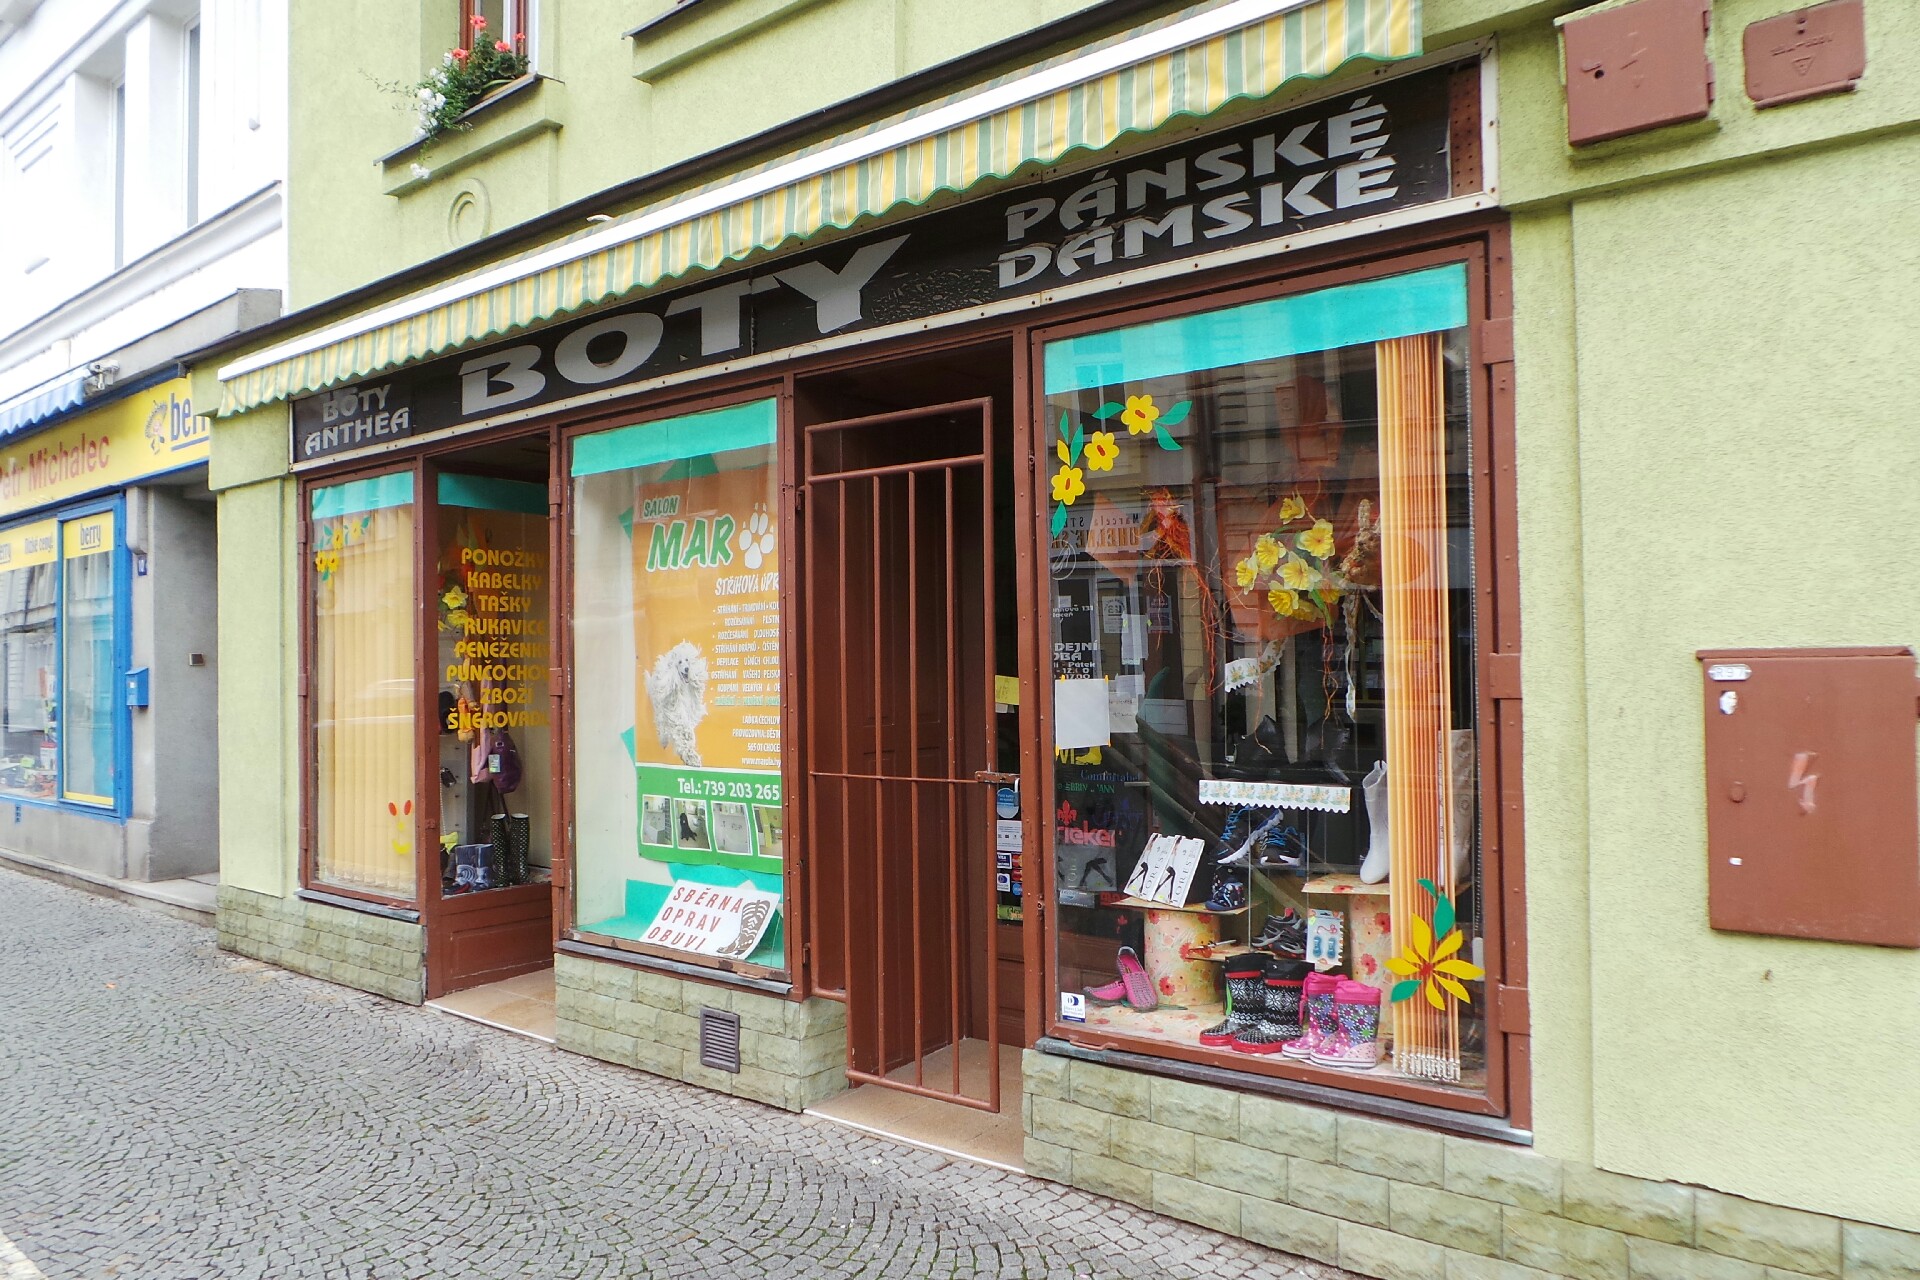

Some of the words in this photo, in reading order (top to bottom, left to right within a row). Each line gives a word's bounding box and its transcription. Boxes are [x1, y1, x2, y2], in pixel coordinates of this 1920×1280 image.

[1005, 95, 1391, 242] PÁNSKÉ
[998, 147, 1399, 288] DÁMSKÉ
[459, 233, 911, 416] BOTY
[322, 384, 391, 422] BOTY
[305, 407, 409, 455] ANTHEA
[28, 433, 109, 492] Michalec
[643, 495, 680, 519] SALON
[80, 523, 101, 546] berry
[646, 514, 735, 572] MAR
[461, 547, 546, 567] PONOŽKY
[467, 571, 543, 590] KABELKY
[478, 591, 532, 612] TAŠKY
[464, 618, 546, 636] RUKAVICE
[1054, 640, 1098, 652] DEJNÍ
[480, 683, 535, 705] ZBOŽÍ
[677, 778, 702, 795] Tel.:
[703, 780, 725, 796] 739
[729, 782, 752, 799] 203
[754, 783, 779, 800] 265
[673, 887, 743, 914] SBĚRNA
[662, 906, 721, 933] OPRAV
[648, 926, 707, 950] OBUVI
